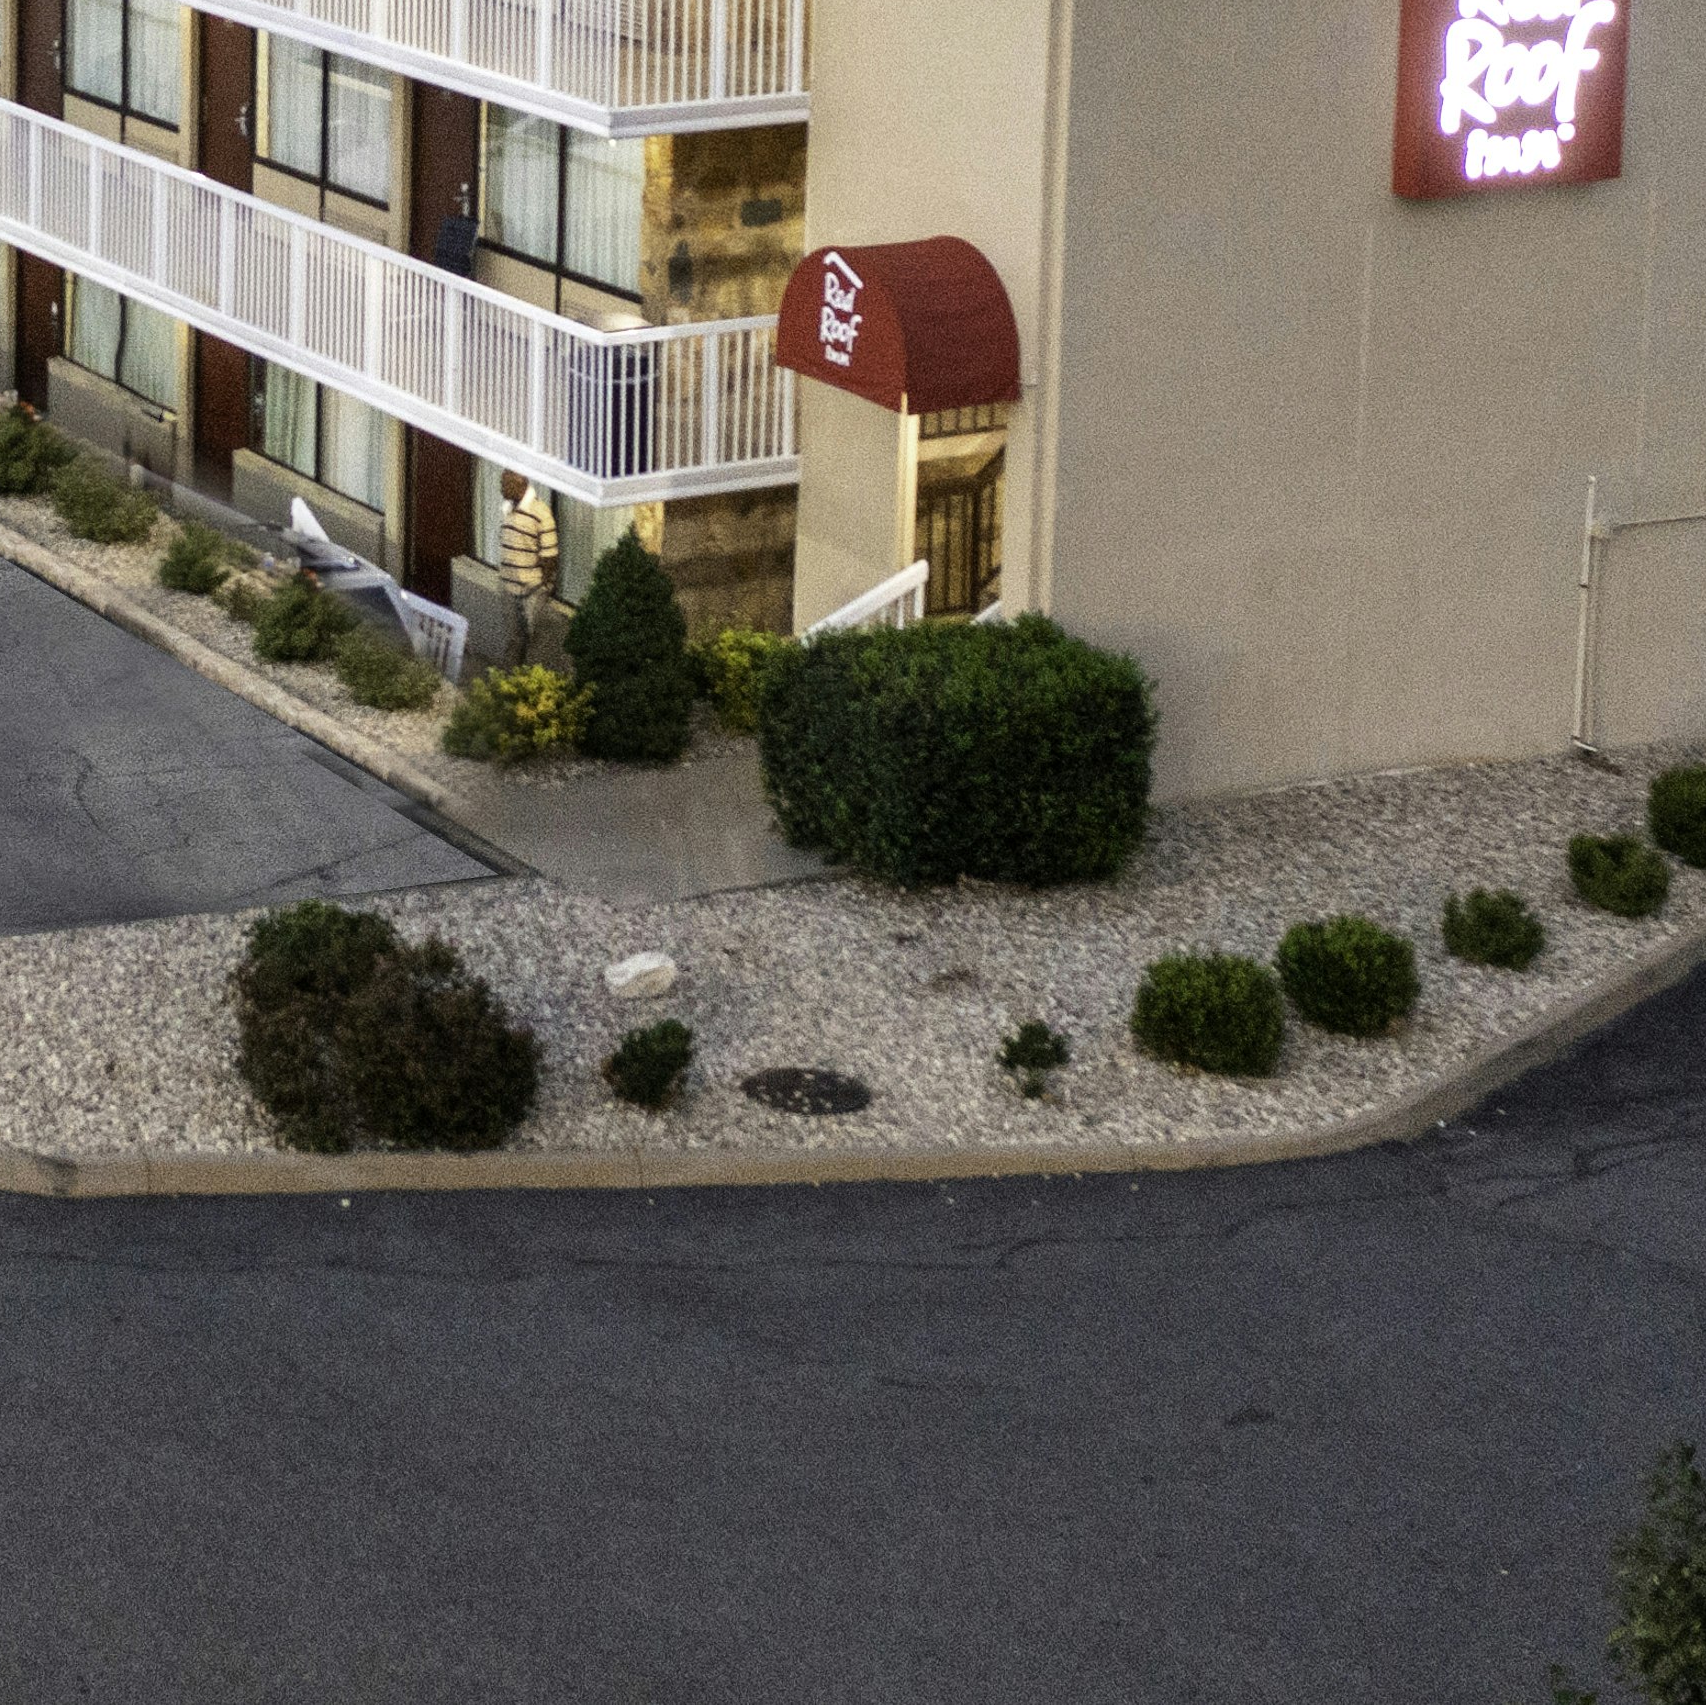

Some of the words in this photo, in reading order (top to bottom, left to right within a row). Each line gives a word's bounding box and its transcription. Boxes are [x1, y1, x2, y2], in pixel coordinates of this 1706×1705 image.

[1440, 0, 1616, 134] Roof
[824, 271, 857, 313] Red
[820, 305, 863, 353] Roof
